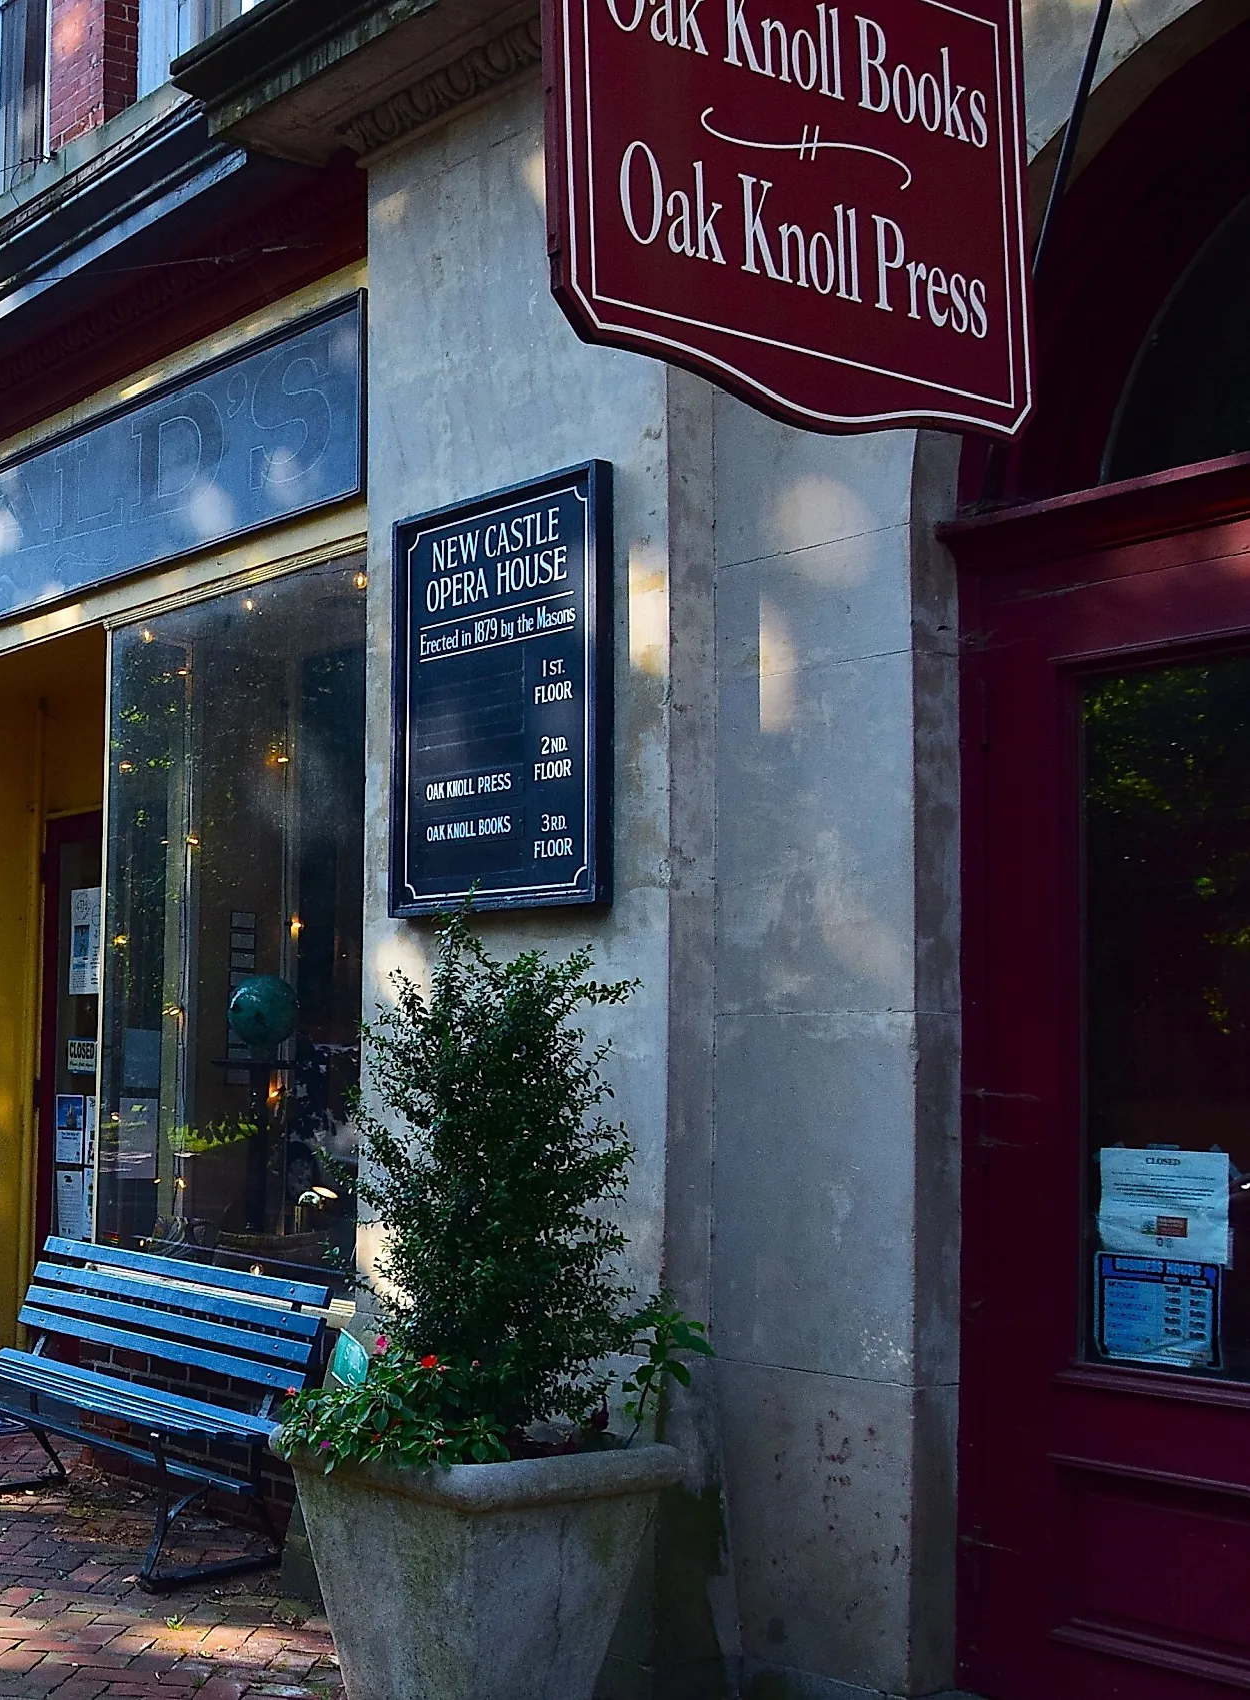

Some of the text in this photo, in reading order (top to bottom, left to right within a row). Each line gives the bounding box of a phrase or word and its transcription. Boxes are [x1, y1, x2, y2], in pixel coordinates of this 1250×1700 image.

[724, 0, 845, 101] Knoll
[855, 15, 988, 149] Books
[619, 140, 988, 339] Oak Knoll Press
[431, 506, 560, 573] NEW CASTLE
[426, 545, 568, 613] OPERA HOUSE
[419, 603, 576, 657] Erected in 1879 by the Masons
[534, 680, 573, 705] FLOOR
[534, 759, 572, 782] FLOOR
[426, 772, 512, 802] OAK KNOLL PRESS
[426, 815, 511, 842] OAK KNOLL BOOKS
[533, 838, 573, 859] FLOOR
[70, 1042, 94, 1059] CLOSED
[1145, 1157, 1181, 1166] CLOSED
